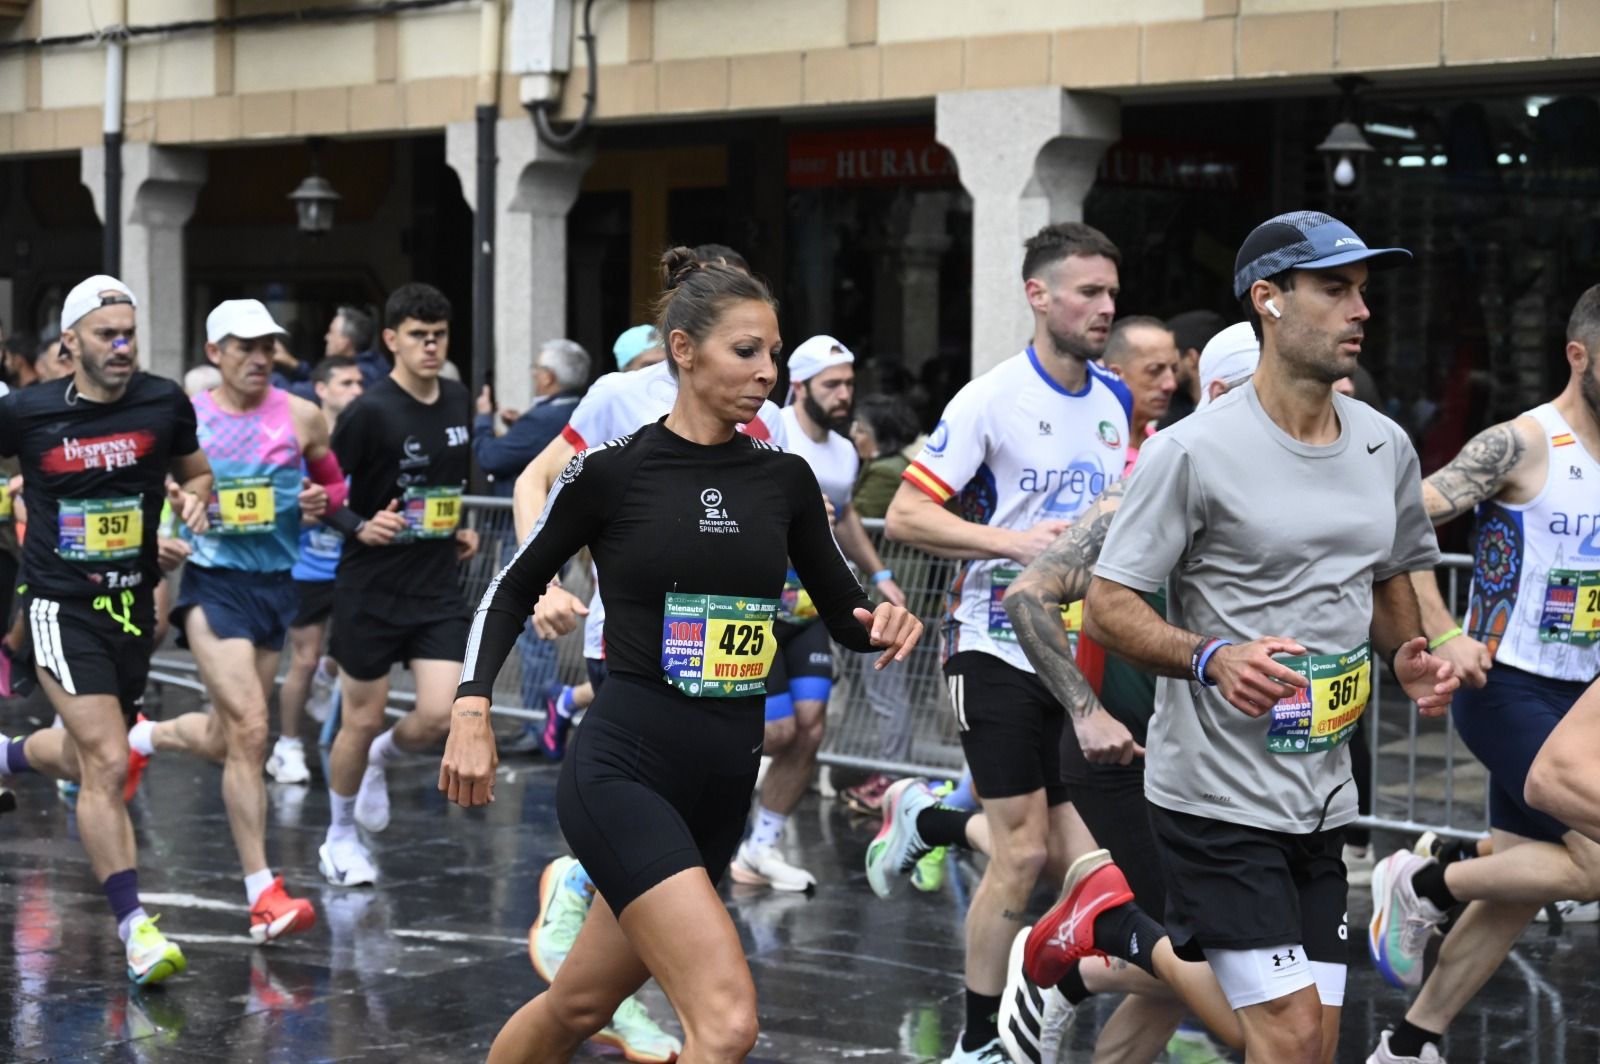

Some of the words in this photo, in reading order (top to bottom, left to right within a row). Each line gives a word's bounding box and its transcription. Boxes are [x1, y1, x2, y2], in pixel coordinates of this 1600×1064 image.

[63, 437, 80, 449] LA
[65, 438, 137, 461] DESPENSA
[84, 457, 101, 469] DE
[105, 451, 138, 472] FER
[235, 491, 257, 509] 49
[98, 515, 129, 536] 357
[668, 603, 704, 613] Telenauto
[669, 621, 703, 641] 10K
[665, 639, 693, 647] CIUDAD
[719, 624, 764, 656] 425
[665, 647, 704, 656] ASTORGA
[689, 656, 701, 667] 26
[715, 663, 738, 678] VITO
[739, 663, 764, 677] SPEED
[1328, 671, 1360, 710] 361
[1274, 703, 1301, 712] CIUDAD
[1301, 702, 1312, 710] DE
[1275, 709, 1312, 720] ASTORGA
